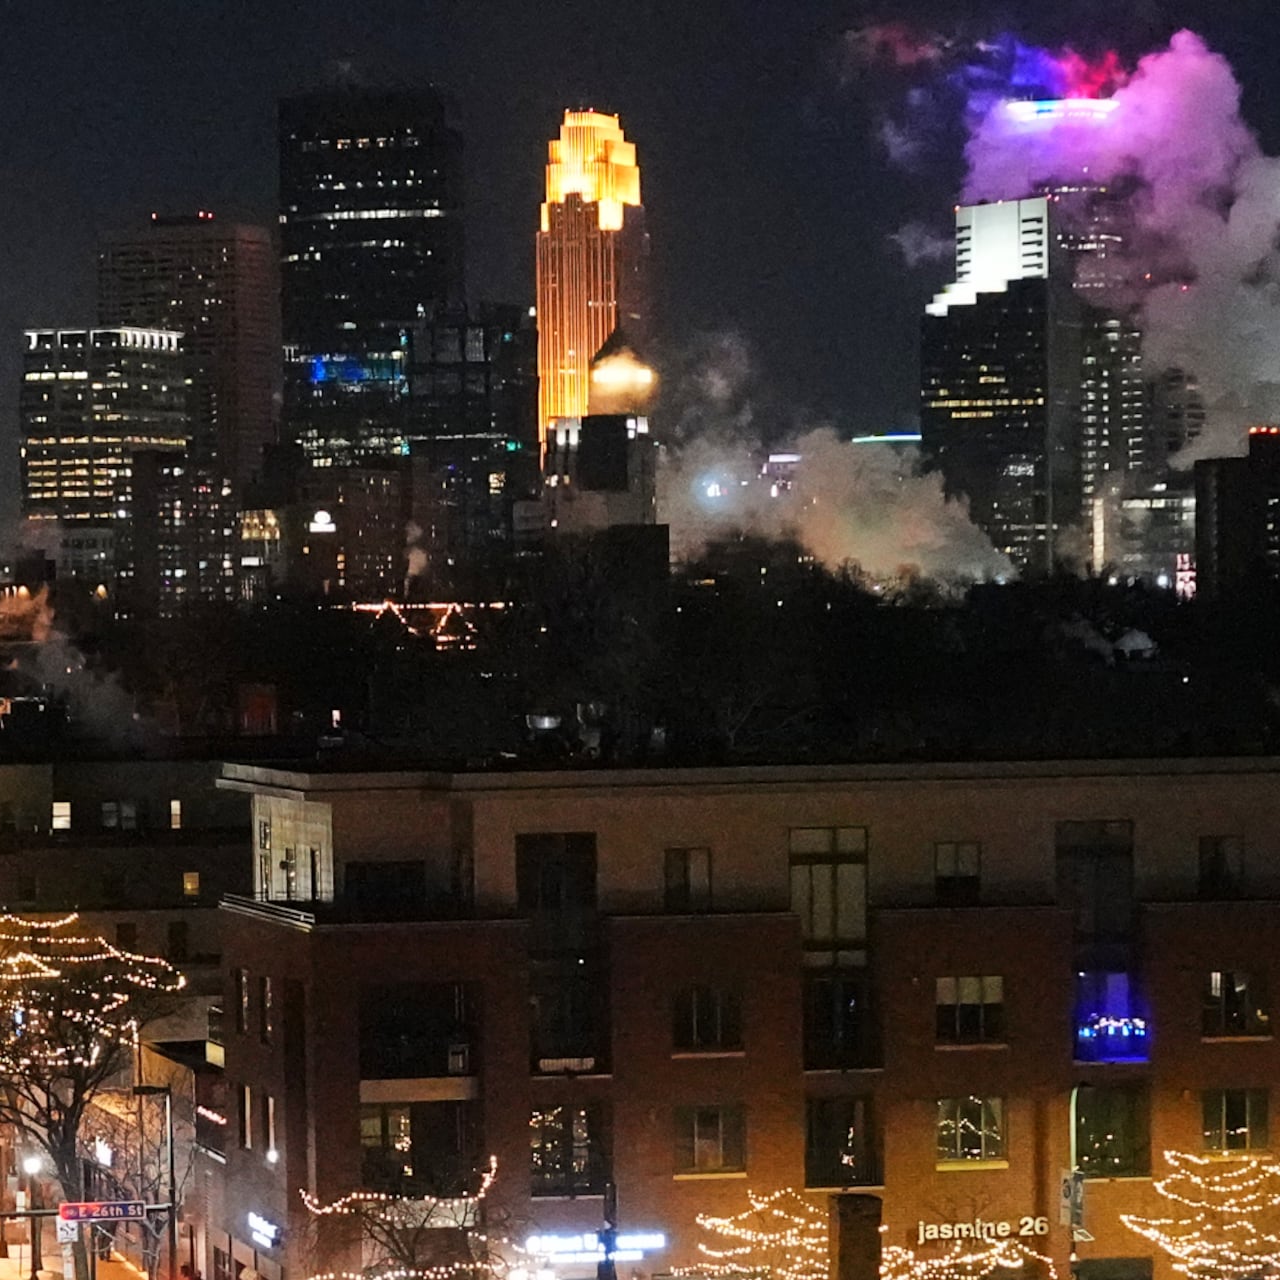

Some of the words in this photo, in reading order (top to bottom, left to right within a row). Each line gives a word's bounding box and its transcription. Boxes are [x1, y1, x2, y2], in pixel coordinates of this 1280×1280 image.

[78, 1206, 87, 1217] E
[92, 1205, 124, 1217] 26th
[127, 1204, 143, 1216] St
[917, 1218, 1012, 1246] jasmine
[1019, 1216, 1050, 1237] 26
